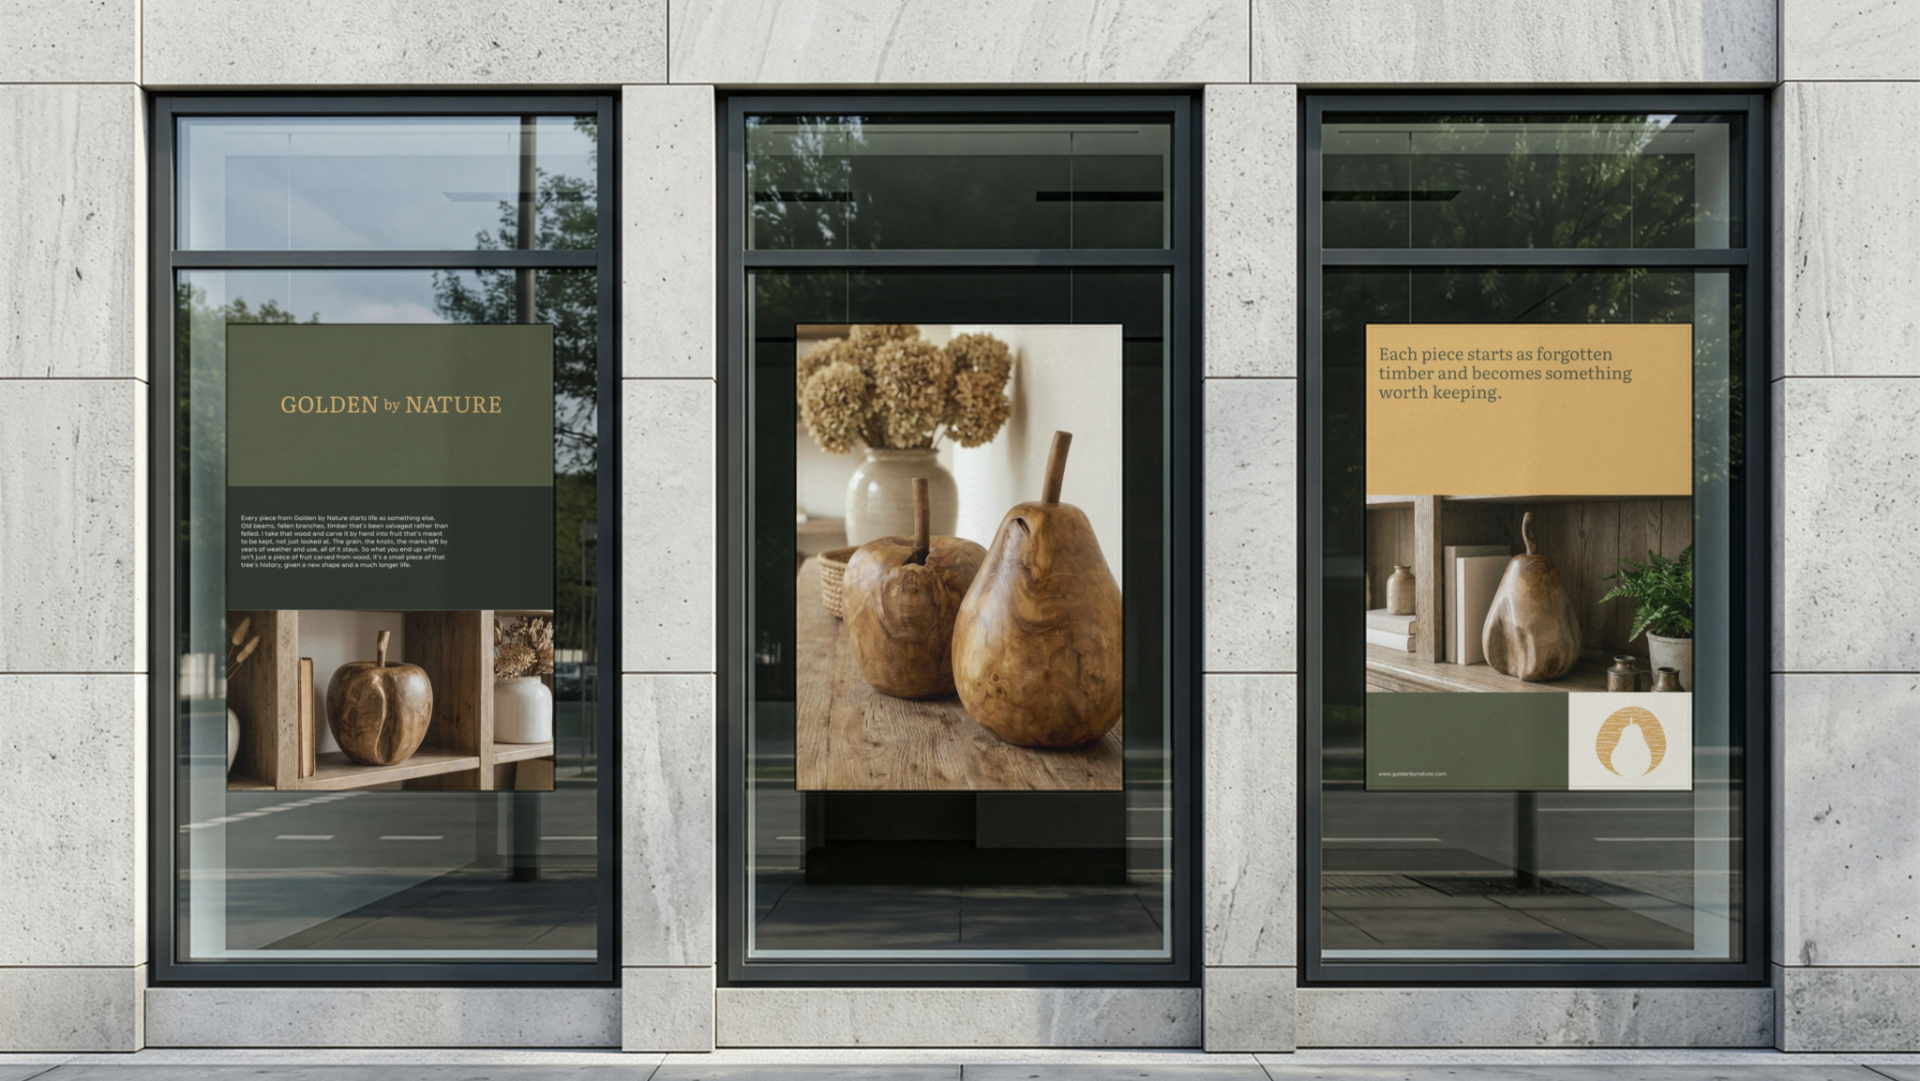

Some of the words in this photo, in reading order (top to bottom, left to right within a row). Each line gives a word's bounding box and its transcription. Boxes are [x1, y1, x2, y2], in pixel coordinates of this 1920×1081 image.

[1380, 347, 1417, 360] Each
[1422, 347, 1463, 364] piece
[1468, 349, 1512, 360] starts
[1517, 351, 1532, 360] as
[1537, 347, 1612, 364] forgotten
[1379, 366, 1434, 379] timber
[1438, 366, 1467, 379] and
[1472, 366, 1541, 380] becomes
[1546, 366, 1632, 383] something
[1379, 385, 1428, 399] worth
[1433, 385, 1501, 402] keeping.
[281, 396, 378, 413] GOLDEN
[384, 398, 400, 413] by
[406, 396, 501, 413] NATURE
